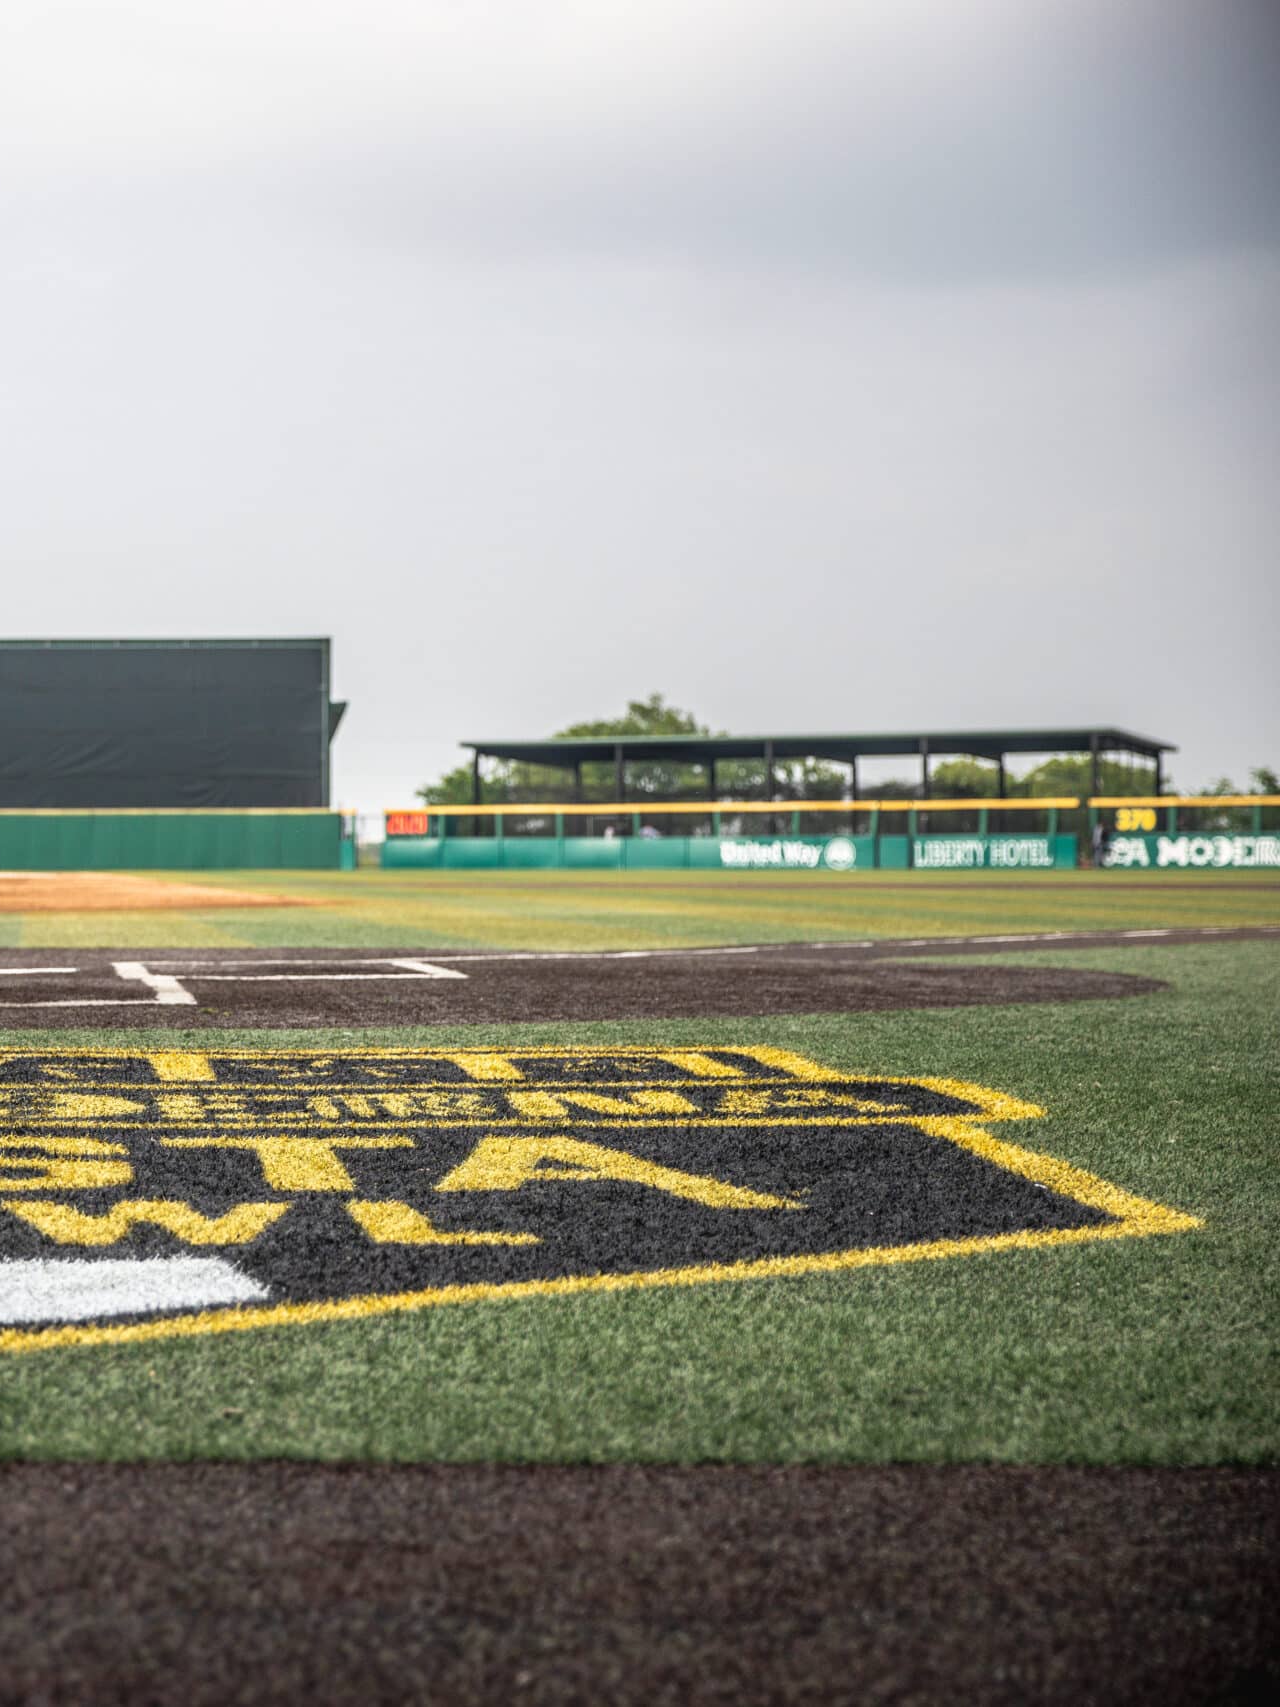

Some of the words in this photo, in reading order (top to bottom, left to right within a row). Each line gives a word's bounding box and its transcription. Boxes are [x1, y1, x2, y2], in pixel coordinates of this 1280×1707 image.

[720, 839, 782, 865] United
[783, 839, 824, 868] Way
[914, 839, 987, 867] LIBERTY
[990, 839, 1054, 867] HOTEL
